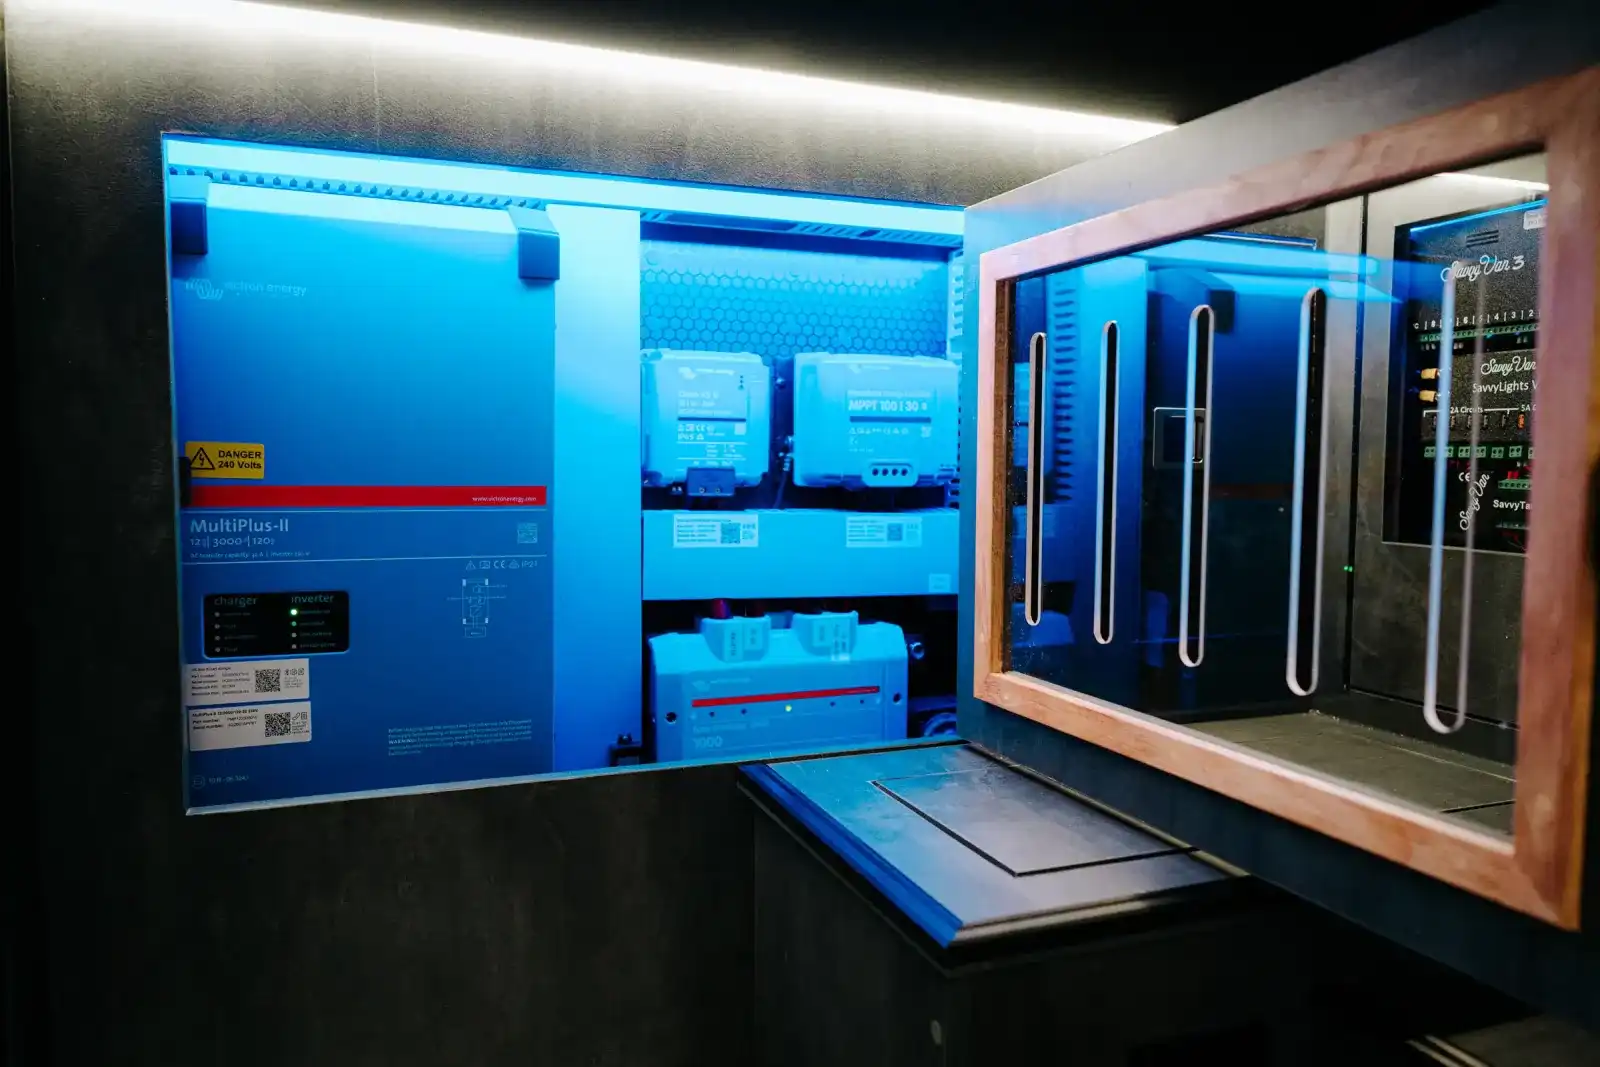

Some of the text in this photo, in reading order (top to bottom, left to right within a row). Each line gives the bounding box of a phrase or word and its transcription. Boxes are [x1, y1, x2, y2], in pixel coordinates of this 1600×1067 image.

[1441, 254, 1525, 281] Savvy Van 3
[1481, 356, 1537, 376] Savvy Van
[1472, 381, 1529, 394] SavvyLights
[218, 450, 262, 459] DANGER
[218, 460, 262, 469] 240 Volts
[1493, 500, 1532, 511] SavvyTa
[190, 519, 289, 533] MultiPlus-II
[214, 594, 335, 607] charger inverter
